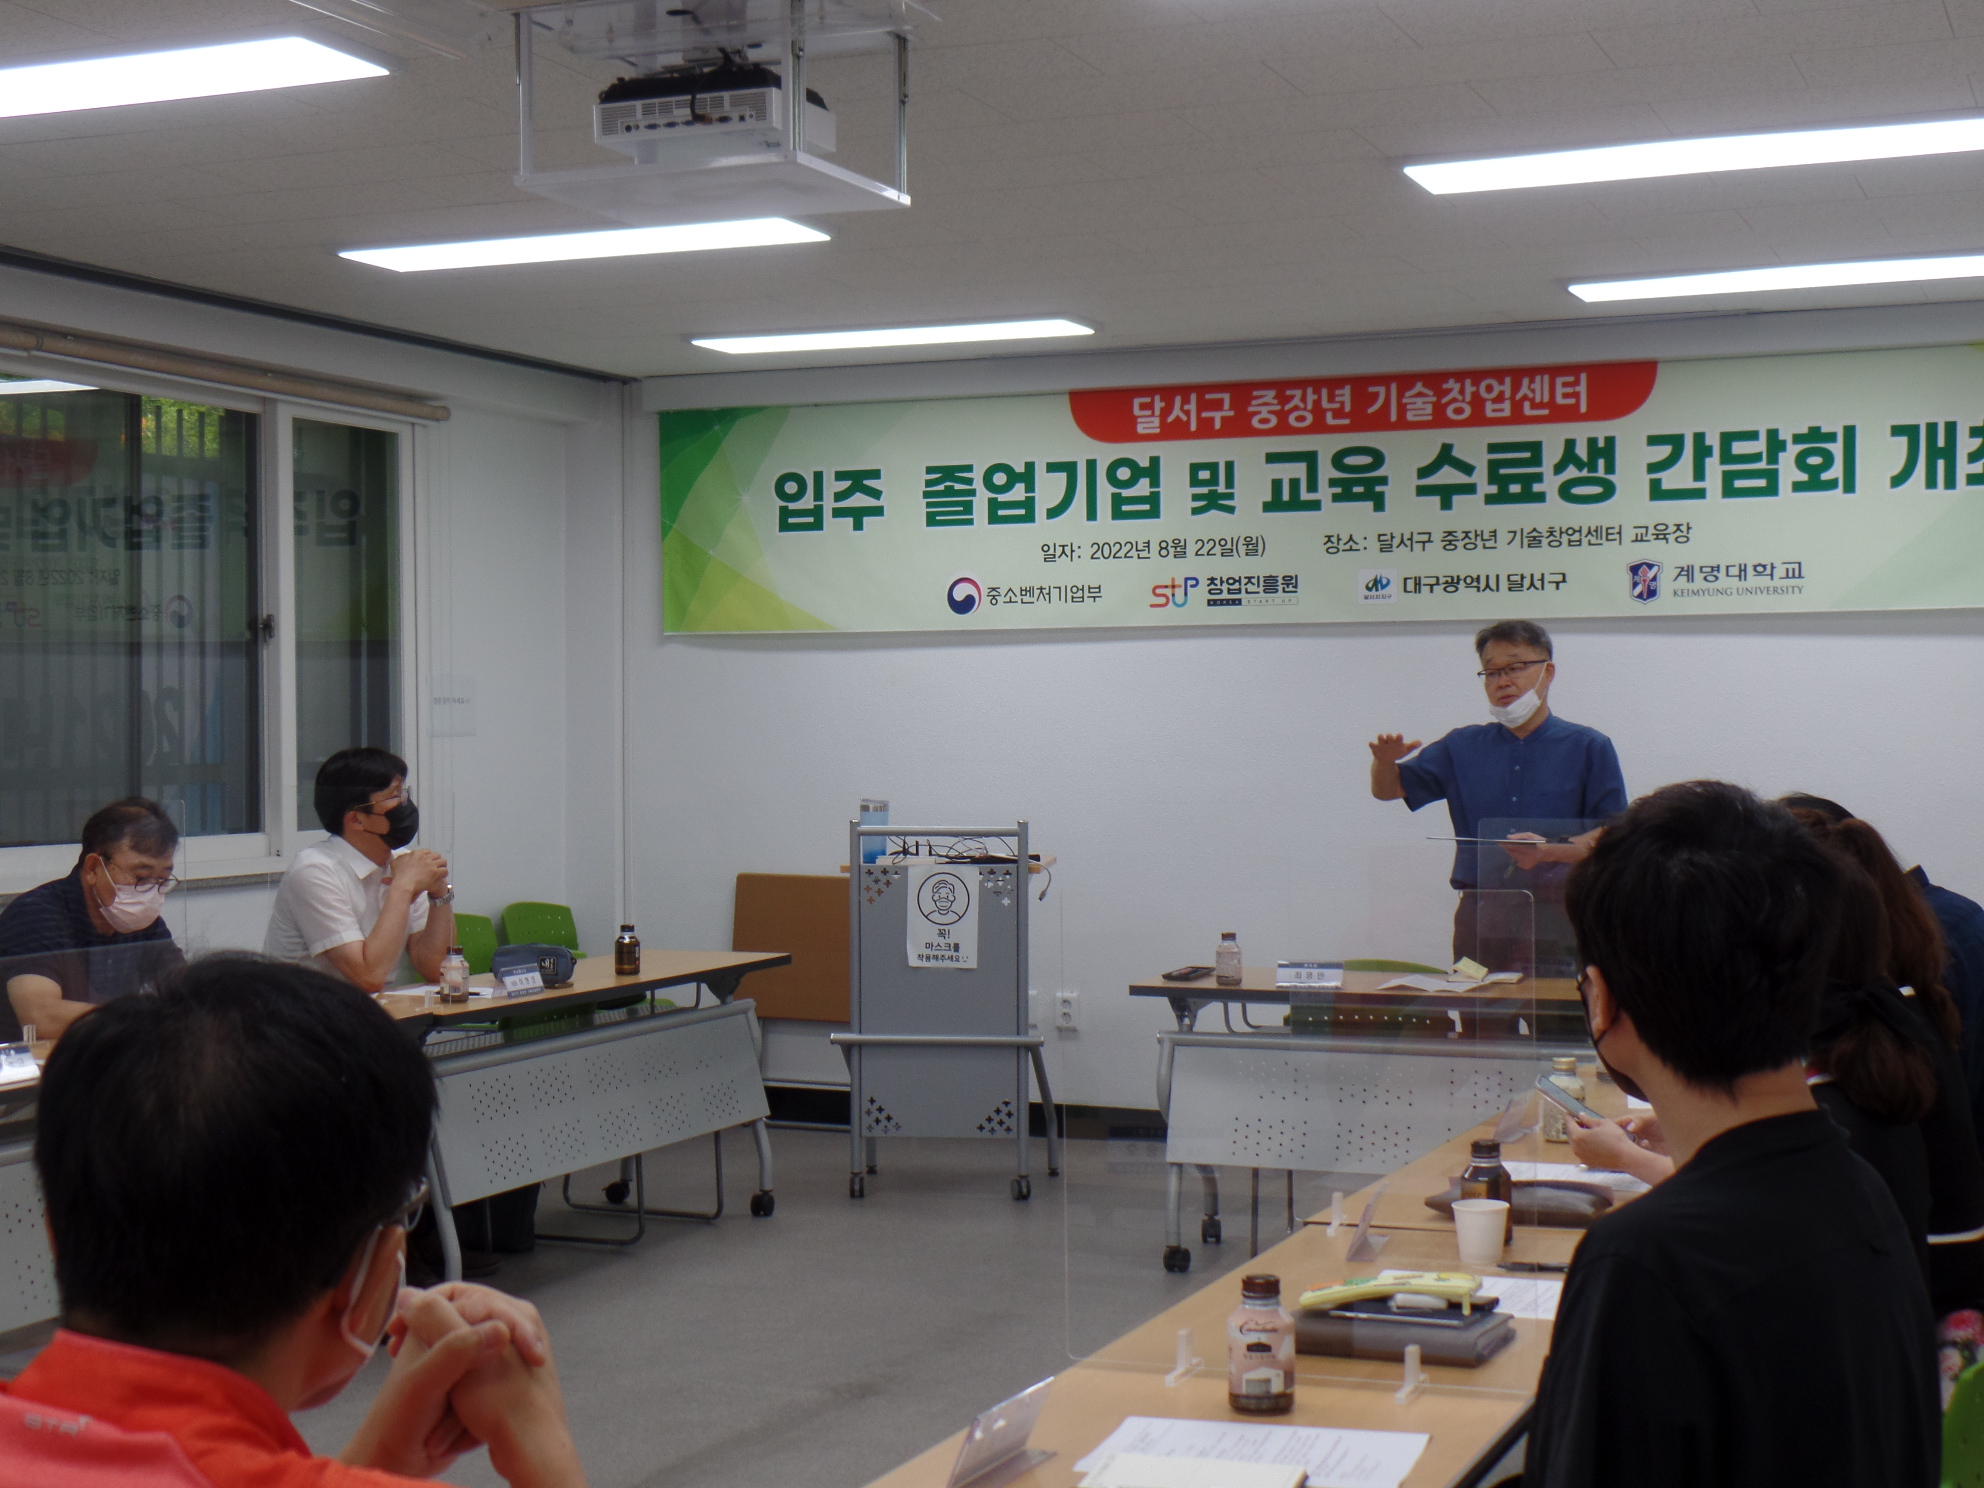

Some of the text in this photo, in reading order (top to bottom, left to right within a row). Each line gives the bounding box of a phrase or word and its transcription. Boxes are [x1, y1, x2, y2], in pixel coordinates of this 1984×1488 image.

[1132, 372, 1588, 434] 달서구 중장년 기술창업센터
[773, 468, 885, 533] 입주
[922, 455, 1161, 528] 졸업기업
[1188, 460, 1237, 516] 및
[1262, 445, 1388, 513] 교육
[1415, 434, 1617, 512] 수료생
[1646, 424, 1857, 502] 간담회
[1041, 534, 1266, 563] 일자: 2022년 8월 22일(월)
[1323, 522, 1693, 555] 장소: 달서구 중장년 기술창업센터 교육장
[1403, 572, 1567, 594] 대구광역시 달서구
[1672, 561, 1805, 584] 계명대학교
[986, 584, 1103, 606] 중소벤처기업부
[1206, 574, 1299, 596] 창업진흥원
[1673, 585, 1804, 598] KEIMYUNG UNIVERSITY
[937, 928, 950, 940] 꼭!
[925, 942, 960, 953] 마스크를
